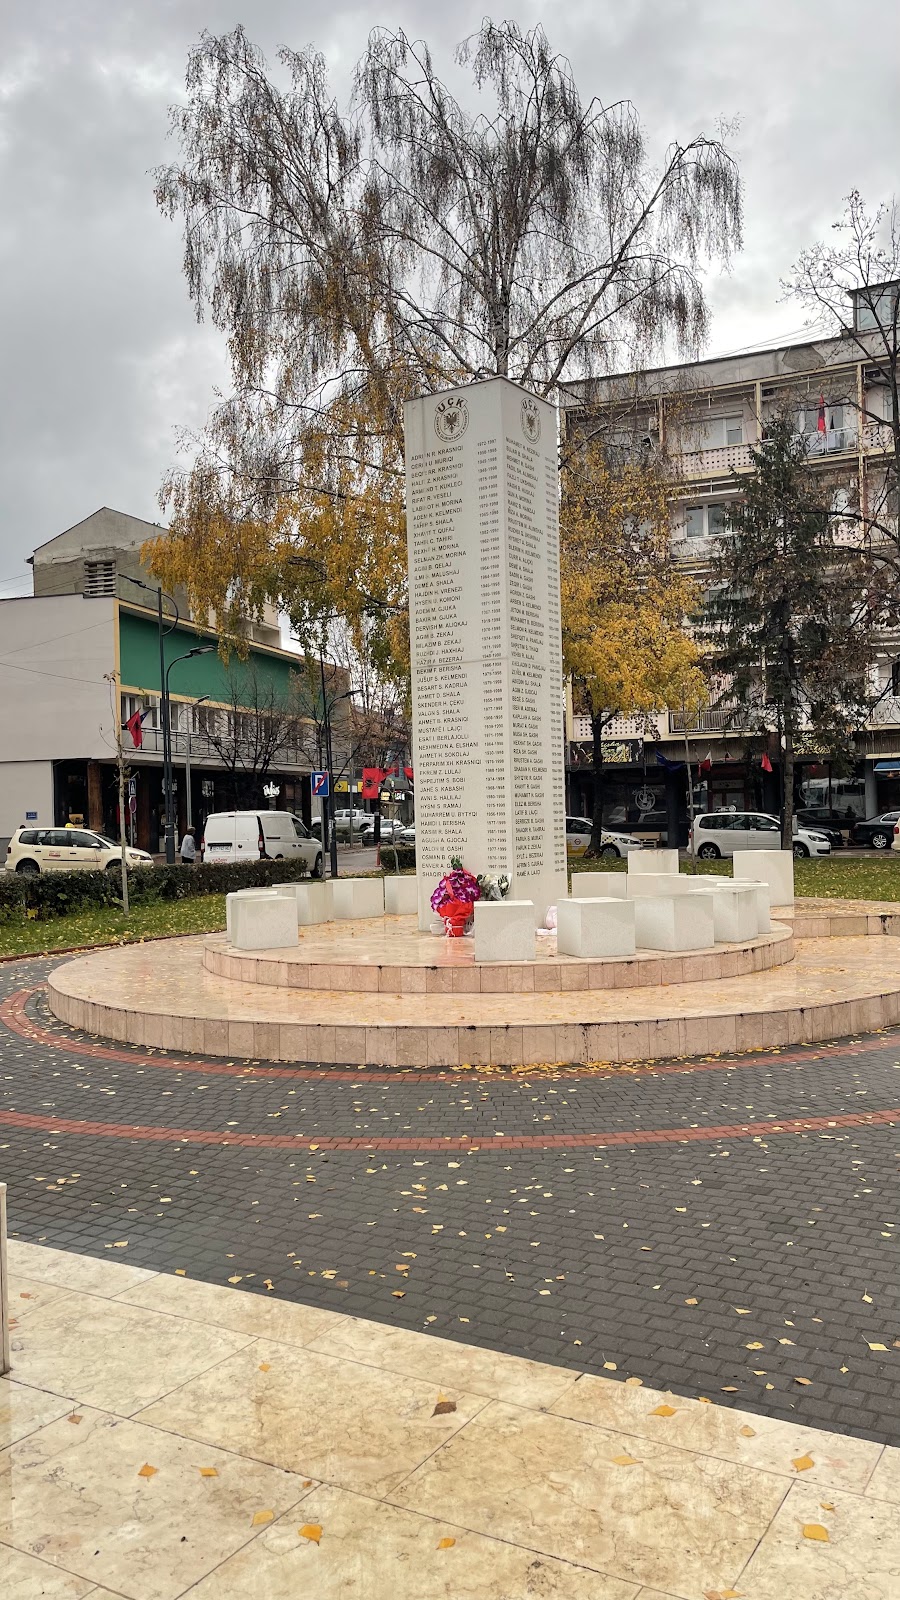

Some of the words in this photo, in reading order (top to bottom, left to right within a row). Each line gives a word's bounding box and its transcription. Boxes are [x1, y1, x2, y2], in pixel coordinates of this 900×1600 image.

[438, 398, 464, 412] UÇK
[411, 452, 430, 461] ADRIN
[438, 445, 463, 455] KRASNIQI
[438, 463, 463, 472] KRASNIQI
[433, 473, 458, 482] KRASNIQI
[412, 486, 433, 495] ARMND
[442, 498, 463, 507] MORINA
[435, 507, 463, 517] KELMENDI
[436, 518, 453, 526] SHALA
[439, 543, 459, 551] MORINA
[414, 556, 435, 564] SELMAN
[446, 550, 466, 558] MORINA
